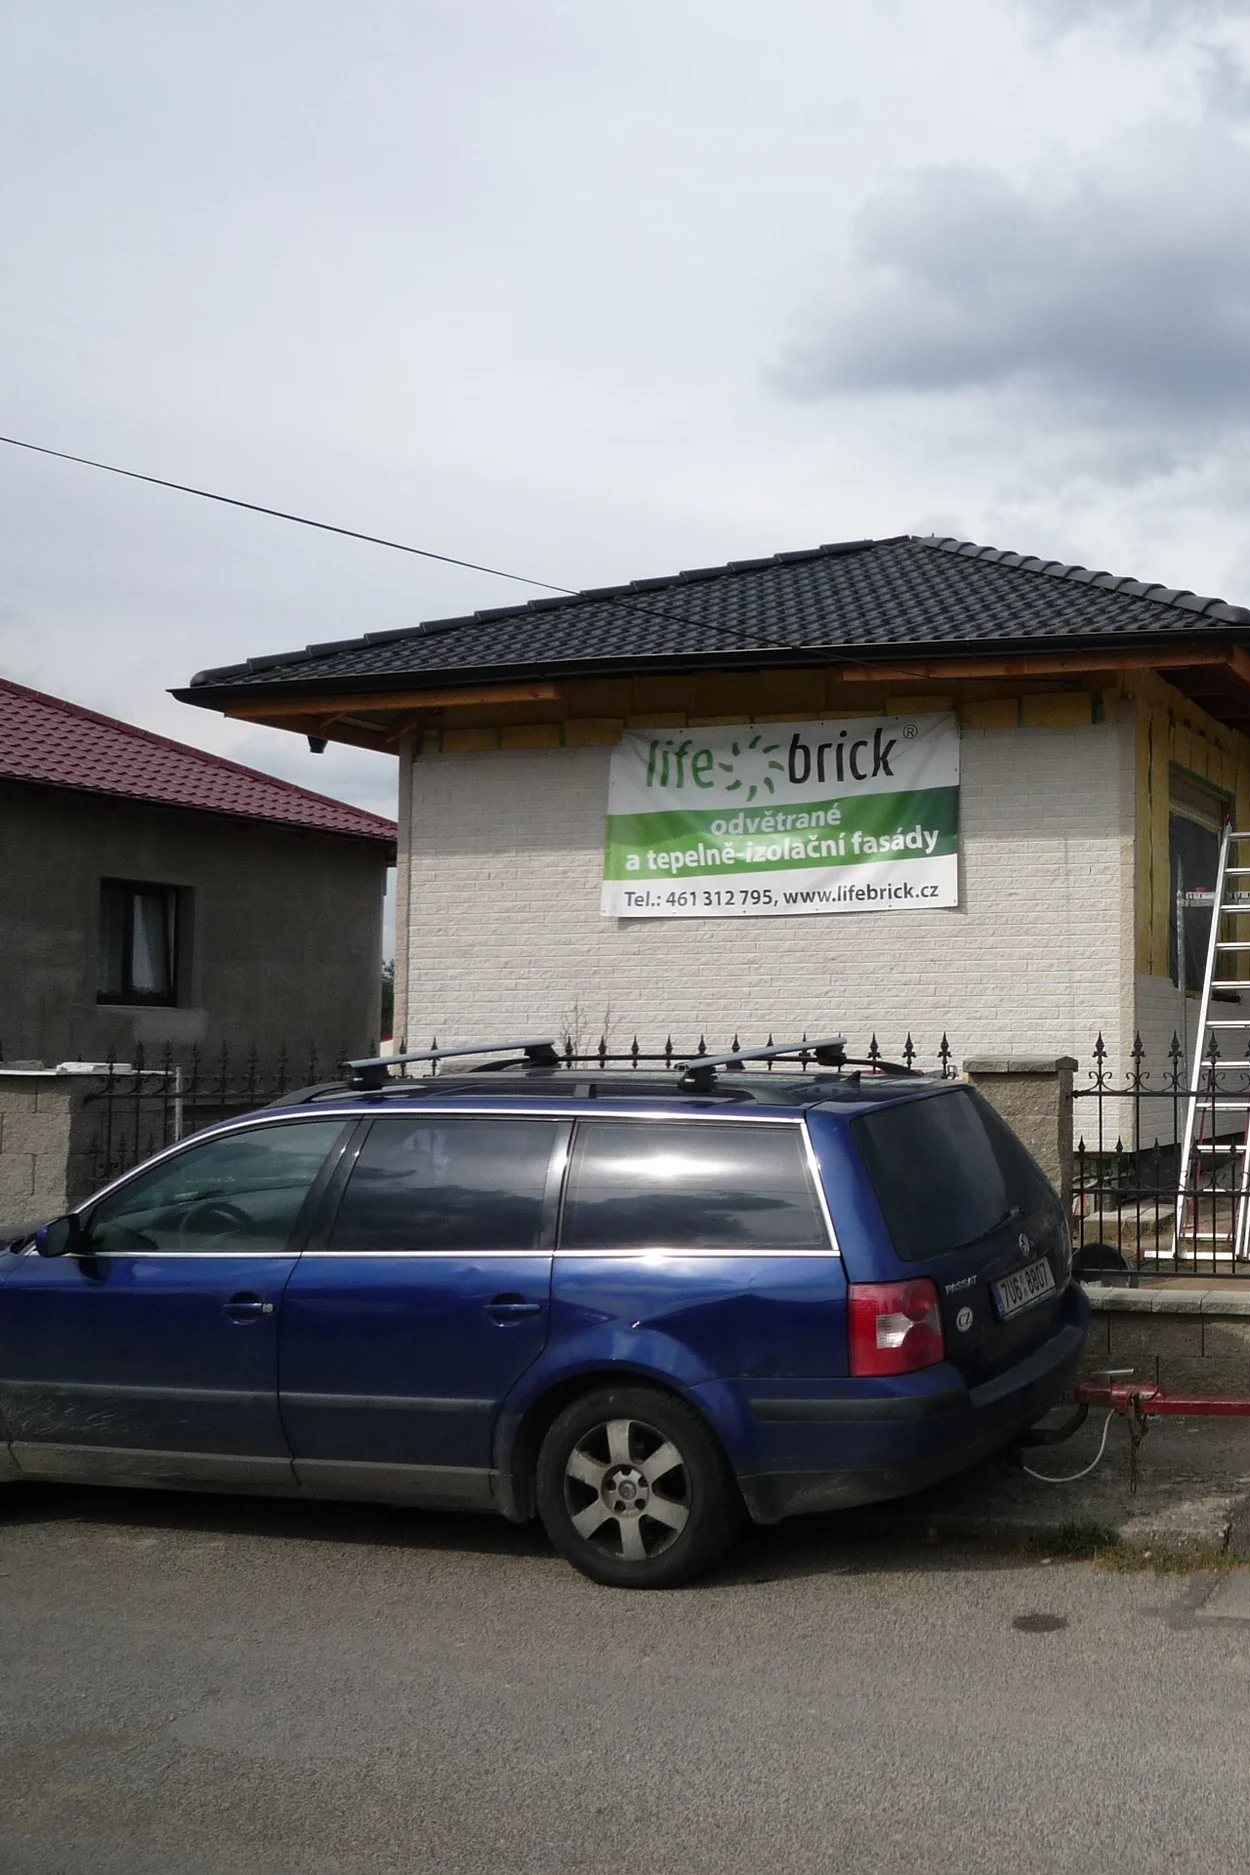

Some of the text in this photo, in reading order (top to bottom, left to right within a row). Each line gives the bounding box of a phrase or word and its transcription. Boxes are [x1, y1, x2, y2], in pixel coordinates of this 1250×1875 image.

[646, 727, 898, 789] life brick
[710, 803, 841, 836] odvětrané
[625, 824, 940, 874] a tepelně-izolační fasády
[624, 882, 940, 907] Tel.: 461 312 795, www.lifebrick.cz
[944, 1274, 979, 1296] PASSAT
[958, 1313, 972, 1326] CZ
